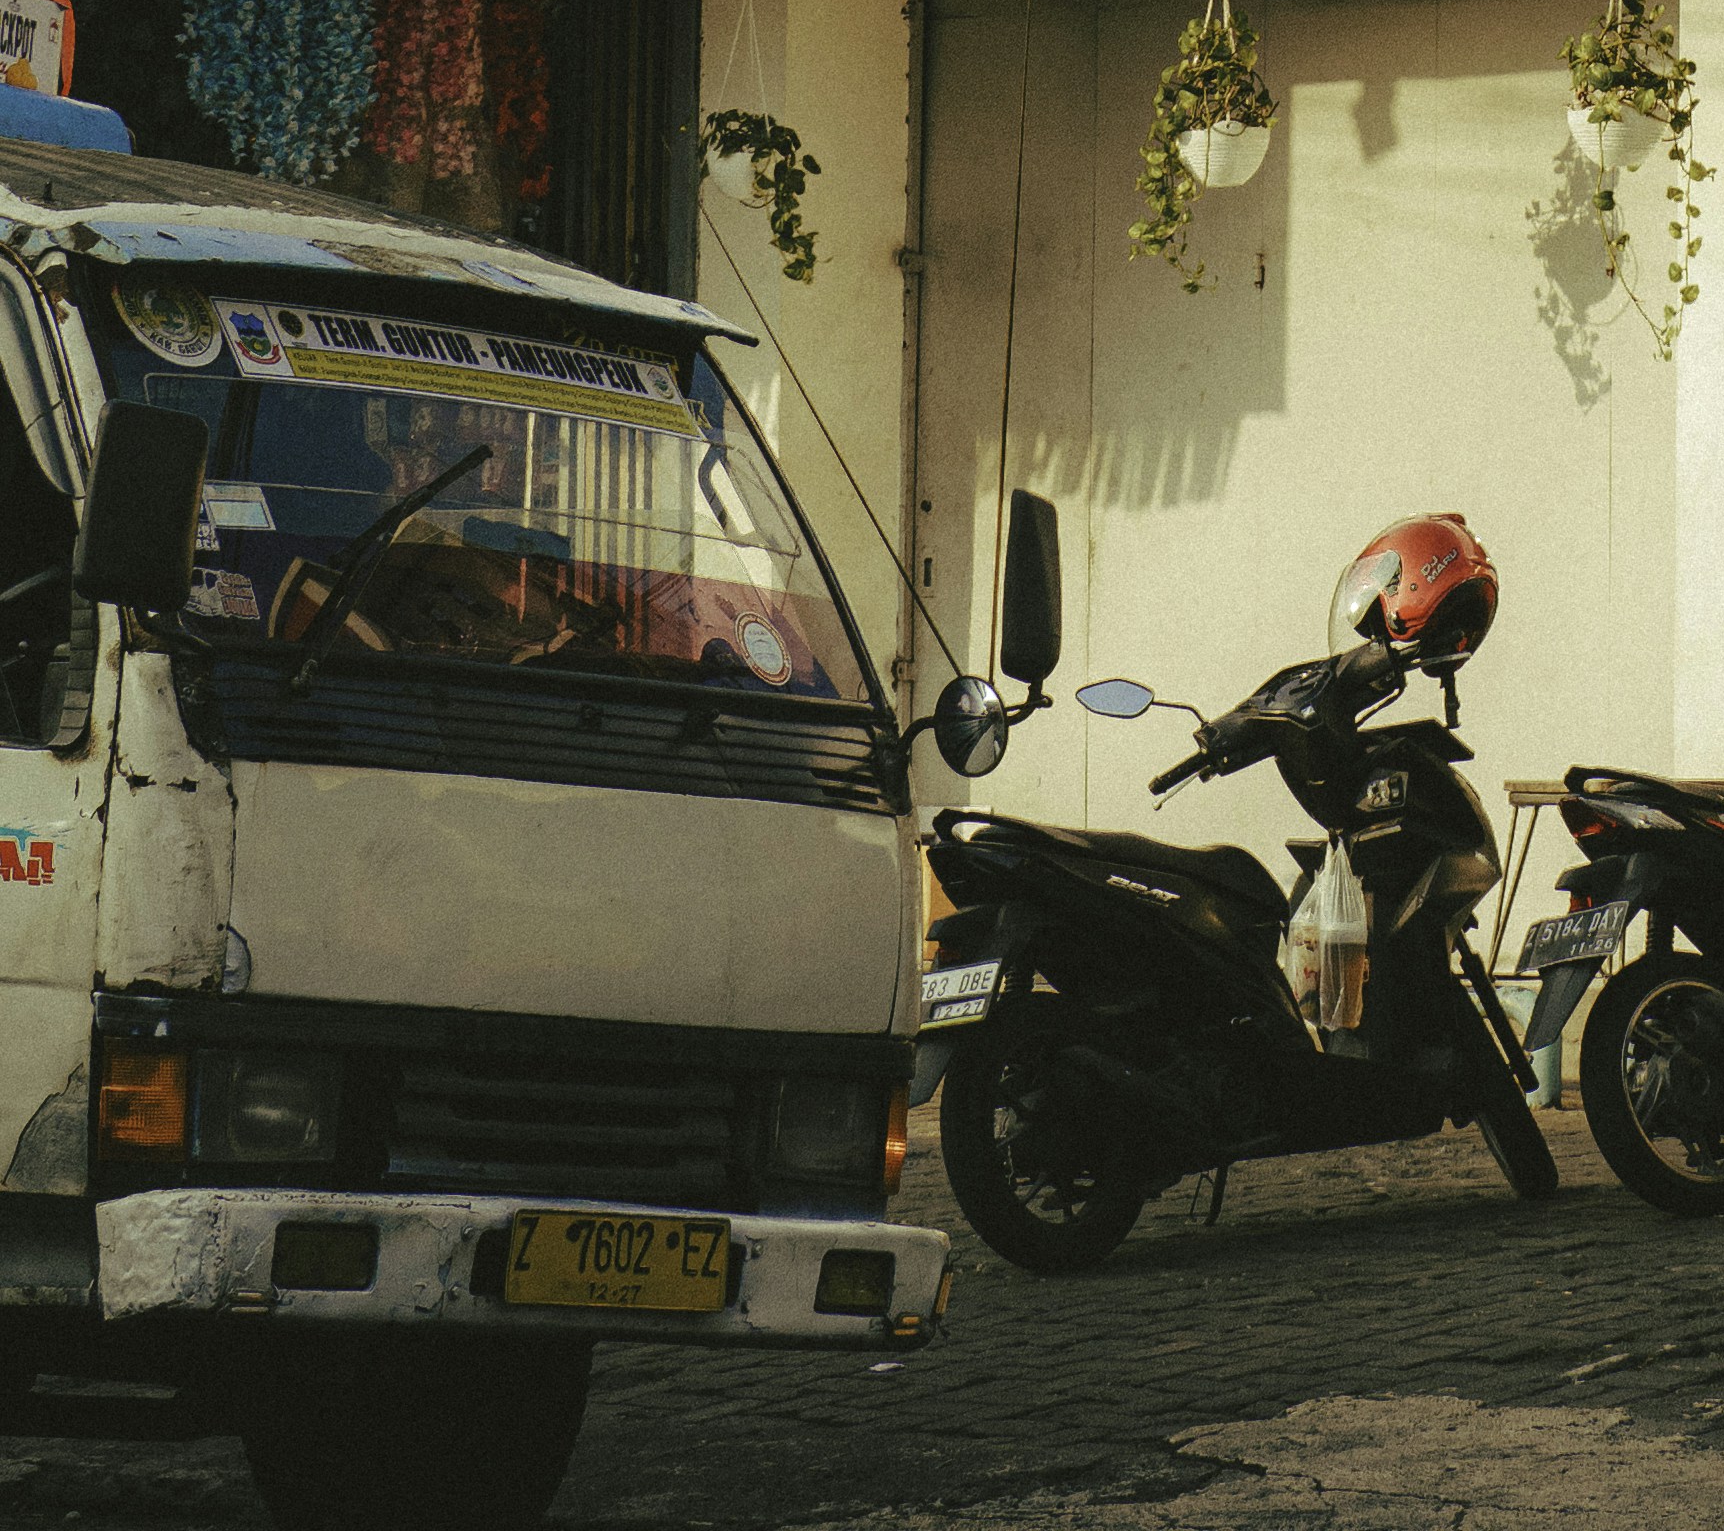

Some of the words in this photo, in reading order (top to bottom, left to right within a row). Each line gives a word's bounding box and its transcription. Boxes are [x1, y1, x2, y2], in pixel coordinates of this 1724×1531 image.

[0, 10, 37, 63] CKPOT
[306, 313, 388, 353] TERM.
[381, 322, 481, 366] GUNTUR
[485, 338, 650, 395] PAMEUNGPEUK
[1525, 926, 1538, 949] Z
[1541, 915, 1584, 942] 5184
[1588, 908, 1624, 933] DAY
[958, 970, 994, 994] DBE
[513, 1216, 541, 1272] Z
[572, 1219, 656, 1275] 7602
[681, 1222, 727, 1279] EZ
